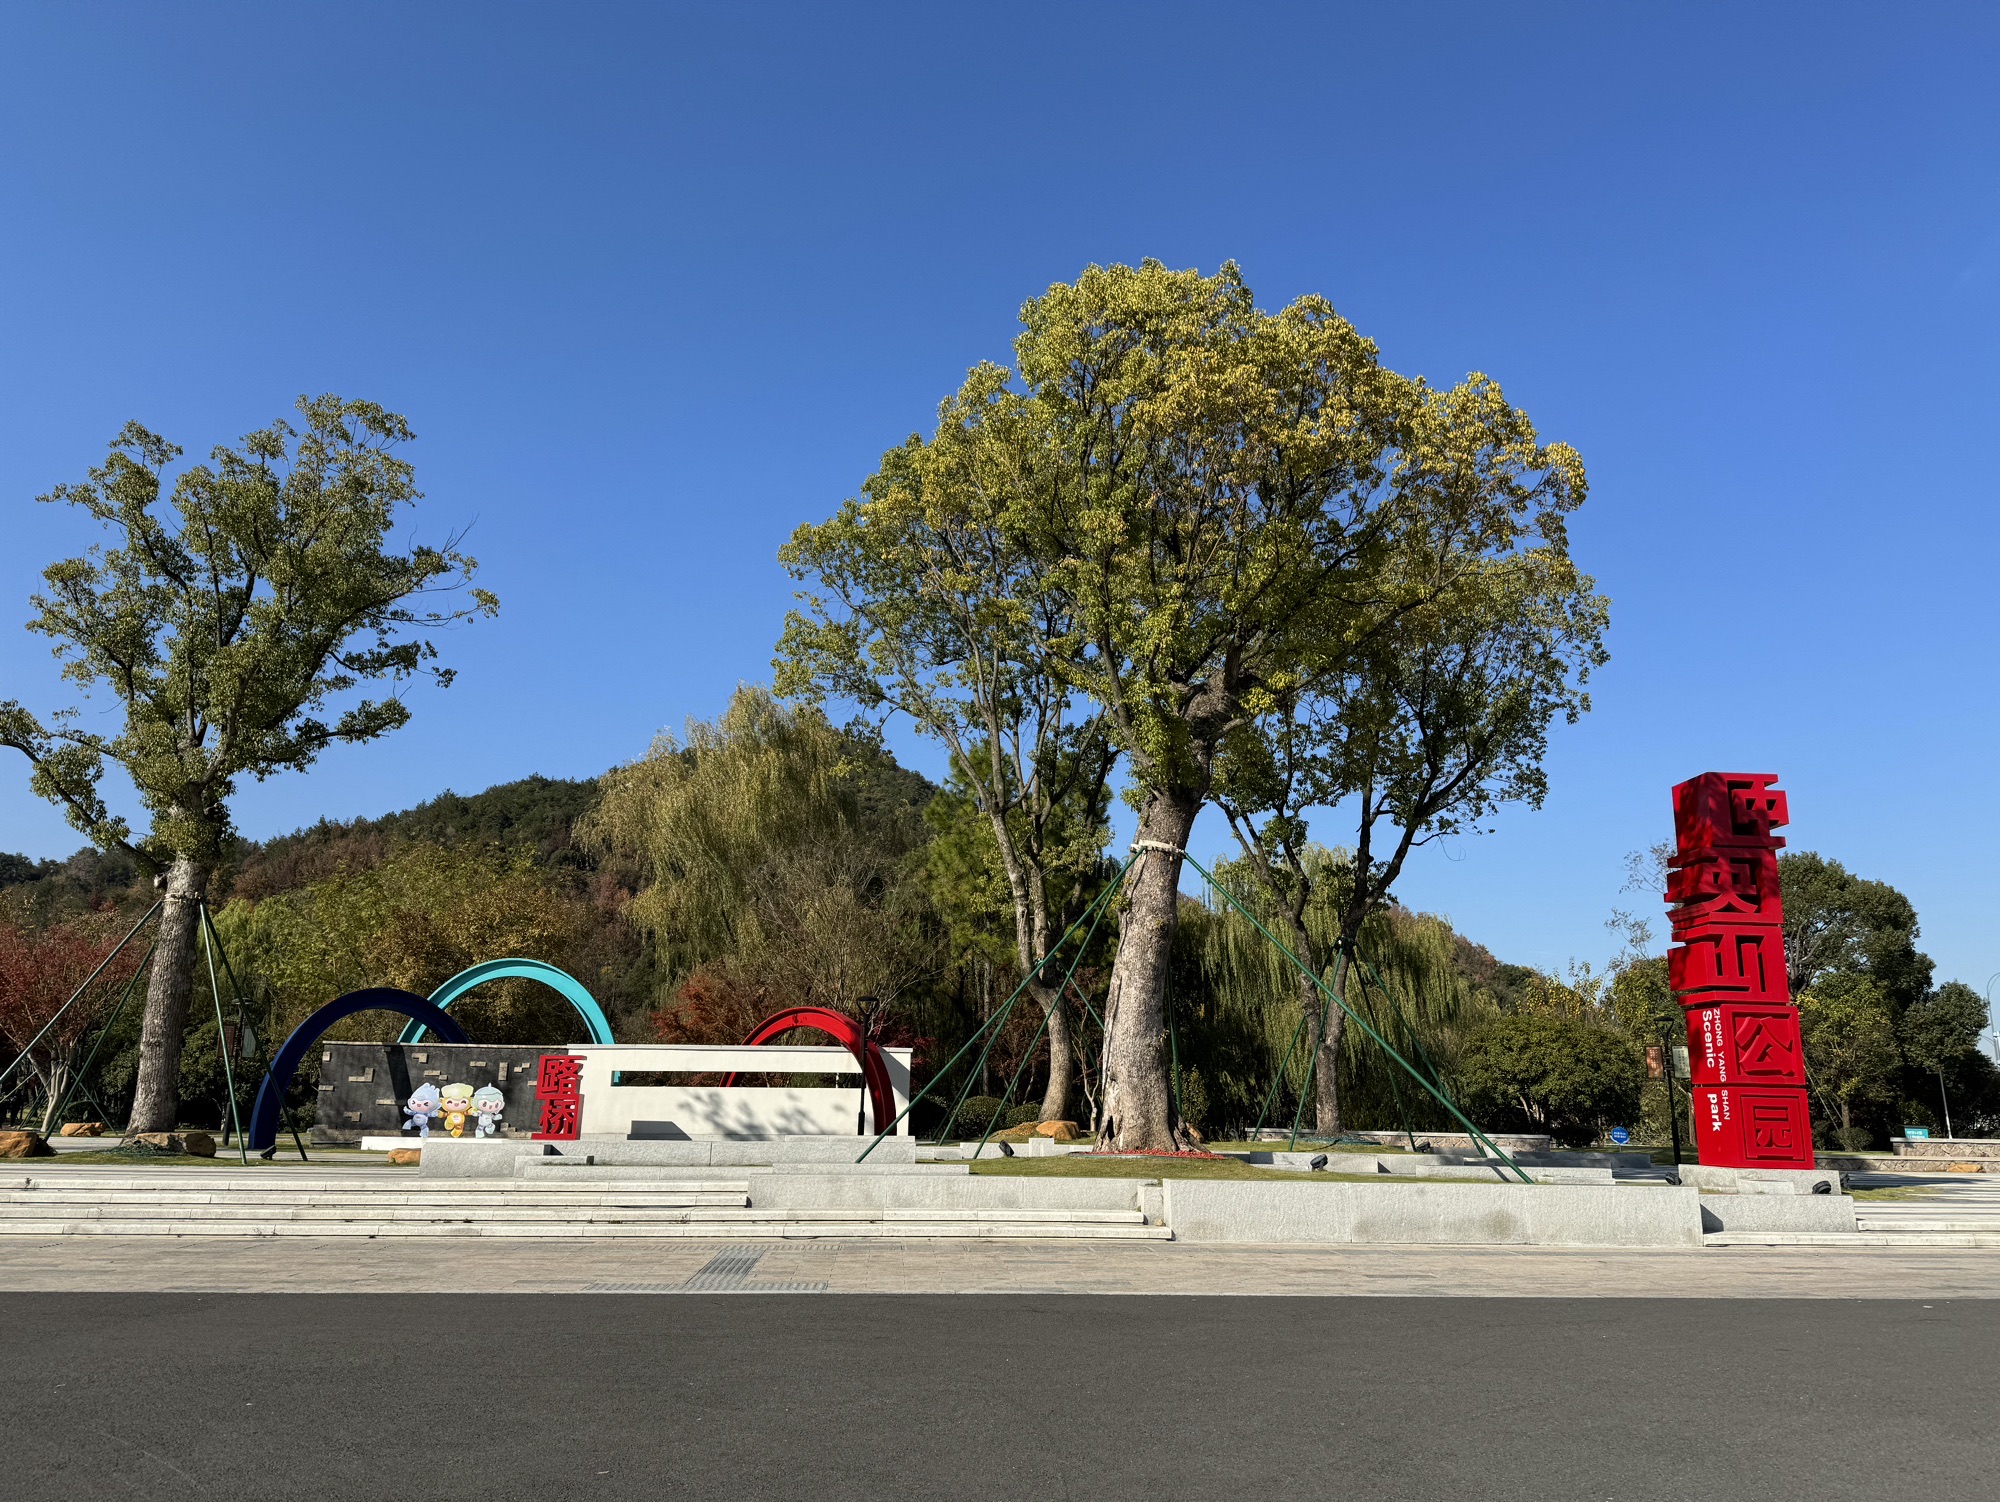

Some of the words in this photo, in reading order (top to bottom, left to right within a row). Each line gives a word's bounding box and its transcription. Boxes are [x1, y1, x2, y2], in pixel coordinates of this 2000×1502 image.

[1702, 1010, 1715, 1068] Scenic
[1713, 1008, 1723, 1047] ZHONG
[1718, 1051, 1727, 1082] YANG
[531, 1055, 587, 1140] 路桥
[1706, 1093, 1723, 1132] park
[1721, 1089, 1731, 1120] SHAN
